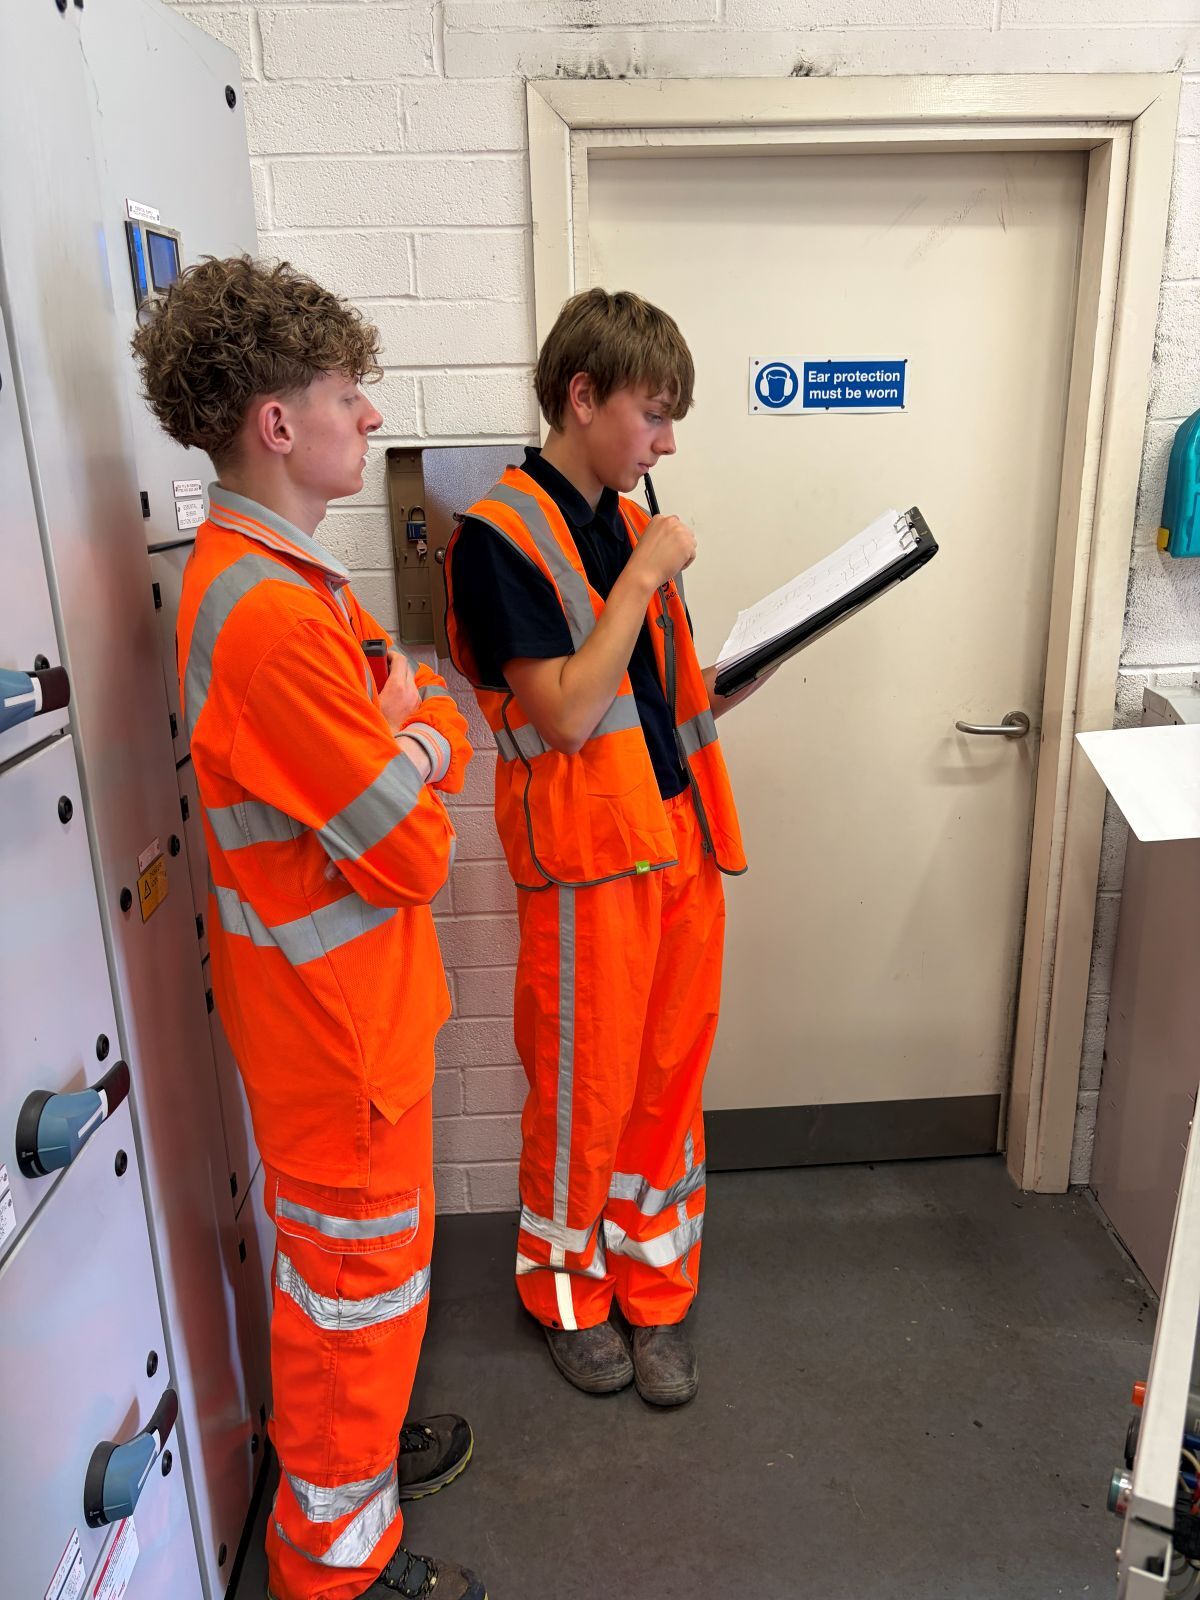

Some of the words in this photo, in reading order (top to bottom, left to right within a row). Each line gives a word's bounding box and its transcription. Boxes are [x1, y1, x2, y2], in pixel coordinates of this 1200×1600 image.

[808, 370, 830, 382] Ear
[833, 370, 900, 385] protection
[809, 388, 842, 399] must
[845, 387, 862, 399] be
[866, 388, 898, 398] worn
